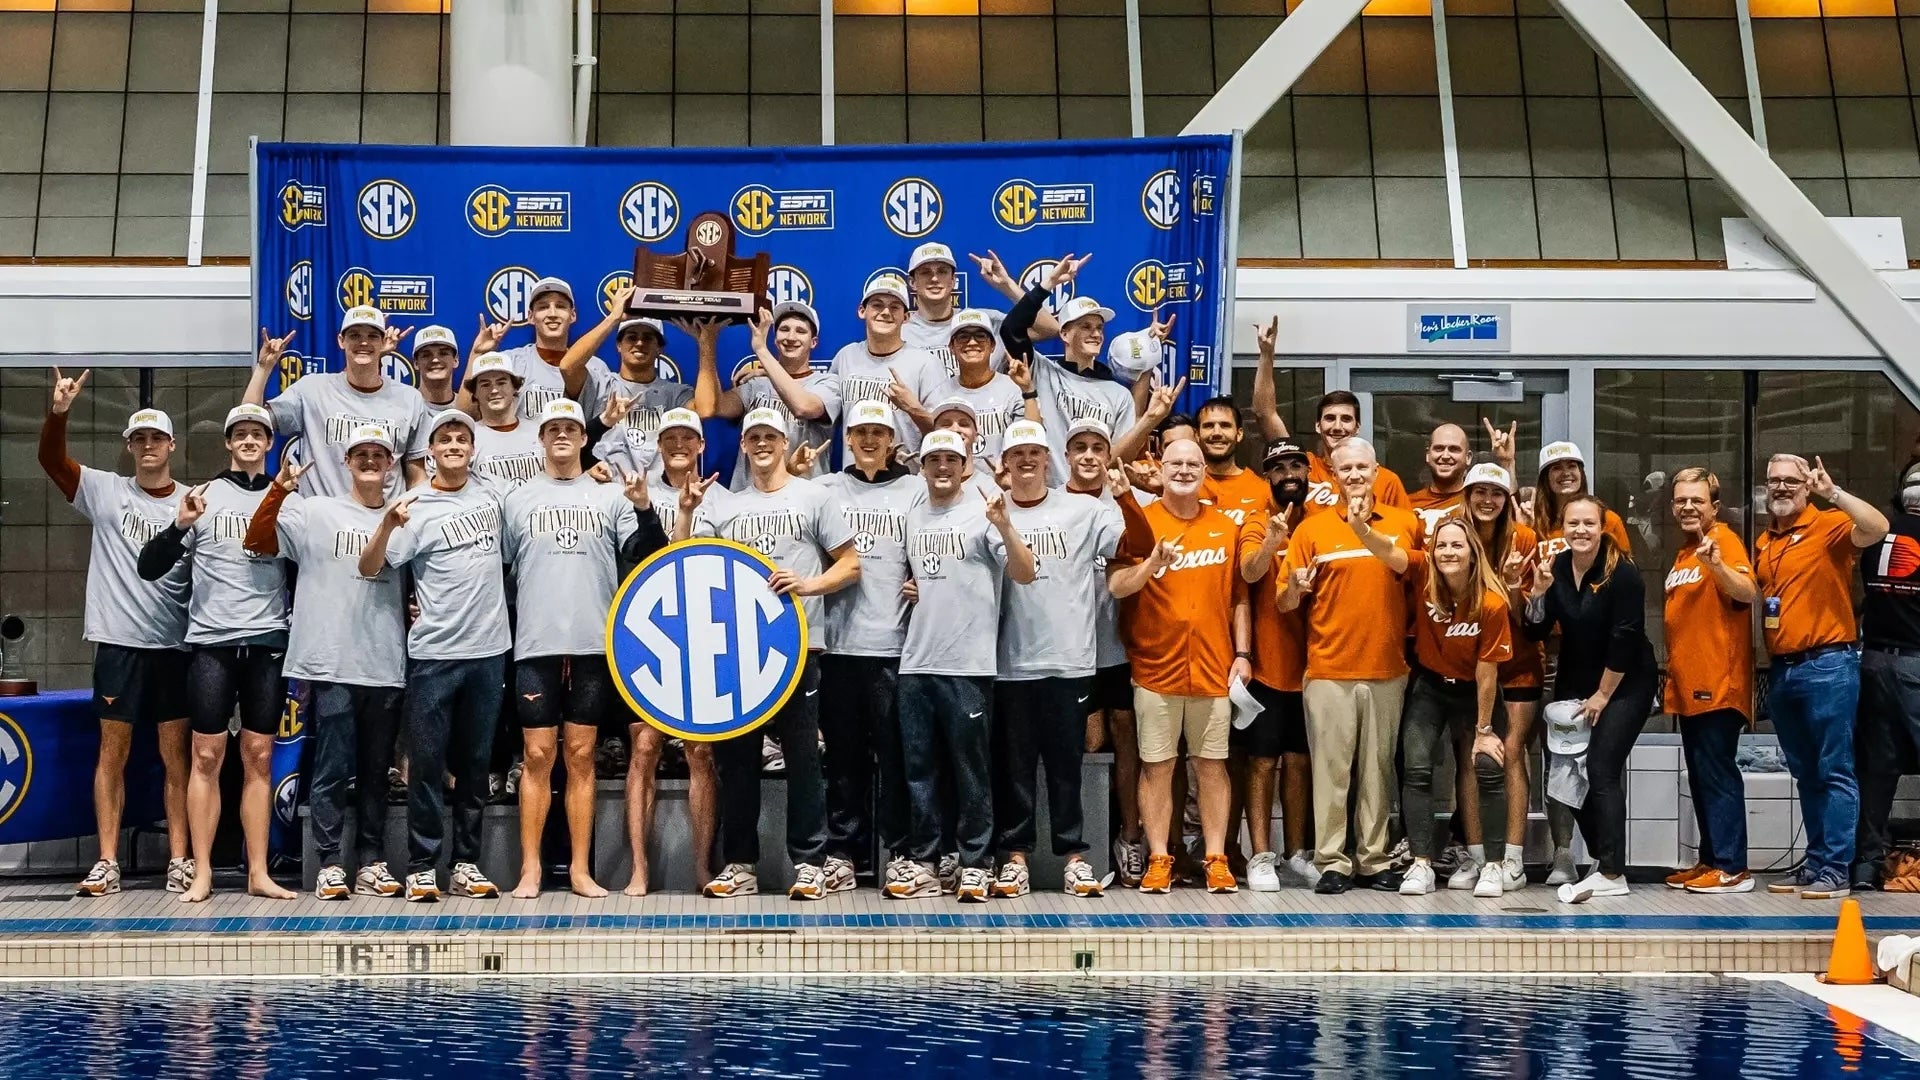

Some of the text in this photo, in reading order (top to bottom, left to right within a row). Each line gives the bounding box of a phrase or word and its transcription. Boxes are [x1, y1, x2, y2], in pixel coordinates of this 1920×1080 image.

[516, 197, 563, 210] ESPN
[779, 195, 826, 209] ESPN
[999, 185, 1037, 225] SEC
[1042, 188, 1086, 202] ESPN
[361, 184, 409, 234] SEC
[472, 190, 511, 231] SEC
[625, 186, 673, 237] SEC
[736, 190, 774, 230] SEC
[888, 182, 936, 233] SEC
[1042, 206, 1086, 219] NETWORK
[516, 216, 563, 227] NETWORK
[780, 213, 827, 225] NETWORK
[698, 222, 720, 245] SEC
[290, 265, 311, 316] SE
[343, 273, 374, 307] SEC
[380, 280, 427, 294] ESPN
[1132, 265, 1166, 306] SEC
[379, 298, 427, 311] NETWORK
[1414, 313, 1502, 334] Men's Locker Room
[530, 510, 603, 539] CHAMPIONS
[556, 527, 579, 549] SEC
[755, 533, 776, 555] SEC
[854, 531, 874, 553] SEC
[623, 554, 788, 725] SEC
